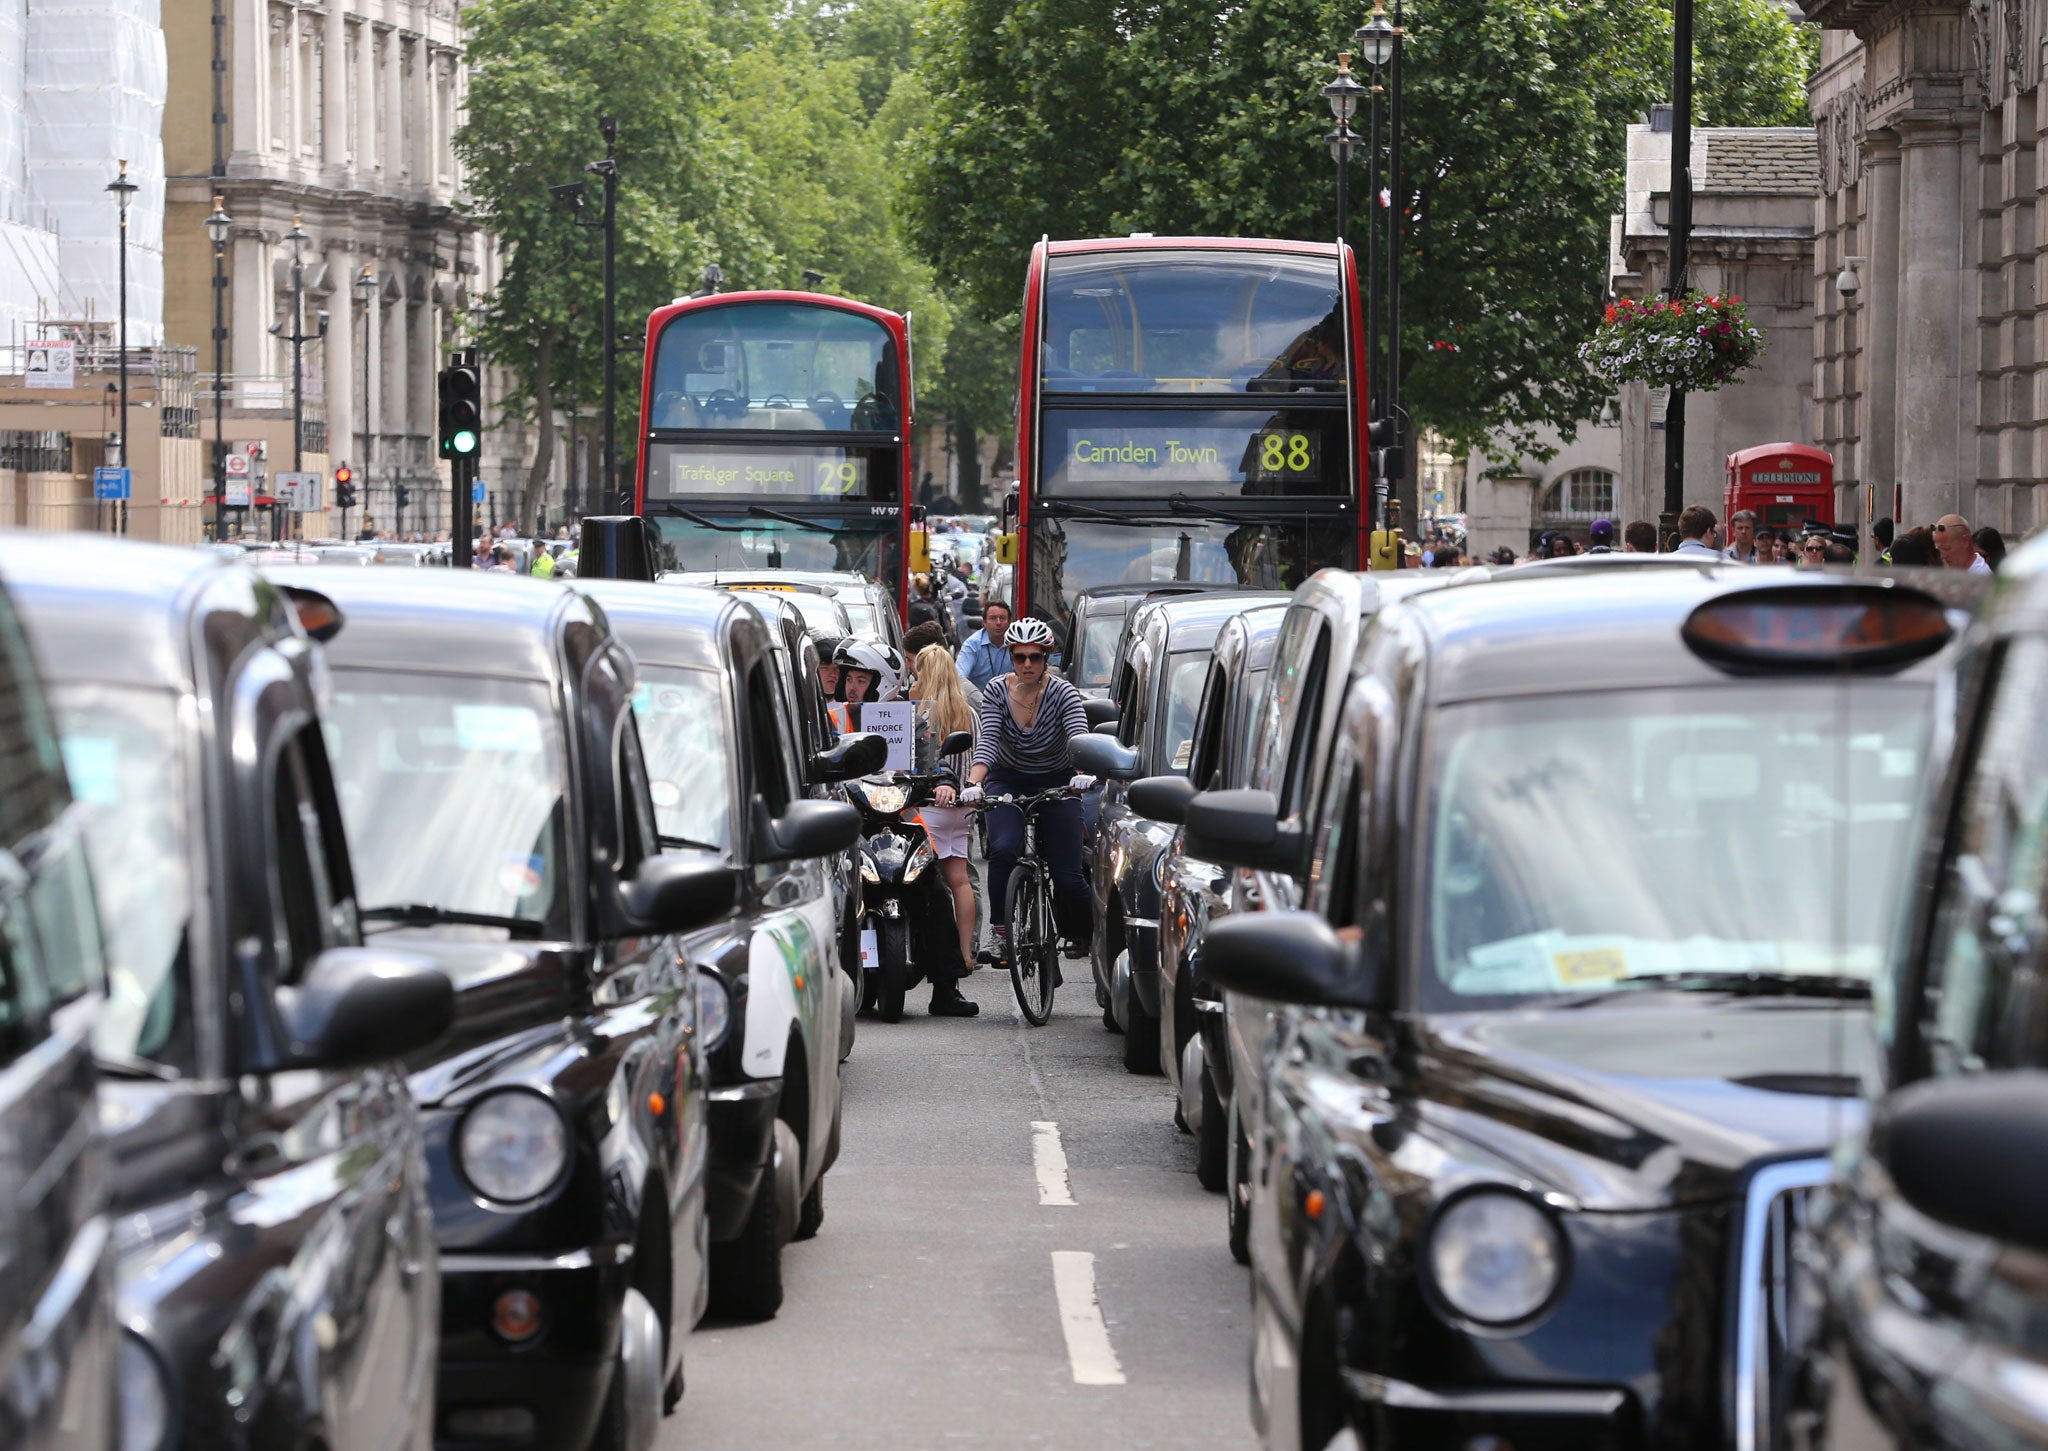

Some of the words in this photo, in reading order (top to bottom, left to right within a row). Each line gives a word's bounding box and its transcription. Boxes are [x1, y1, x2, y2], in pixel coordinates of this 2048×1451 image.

[1074, 440, 1157, 463] Camden
[1165, 440, 1218, 463] Town
[1261, 434, 1311, 472] 88
[678, 464, 739, 486] Trafalgar
[745, 465, 794, 484] Square
[817, 463, 858, 493] 29
[1756, 472, 1818, 483] TELEPHONE
[871, 506, 886, 515] HV
[888, 506, 899, 515] 97
[867, 724, 903, 732] ENFORCE
